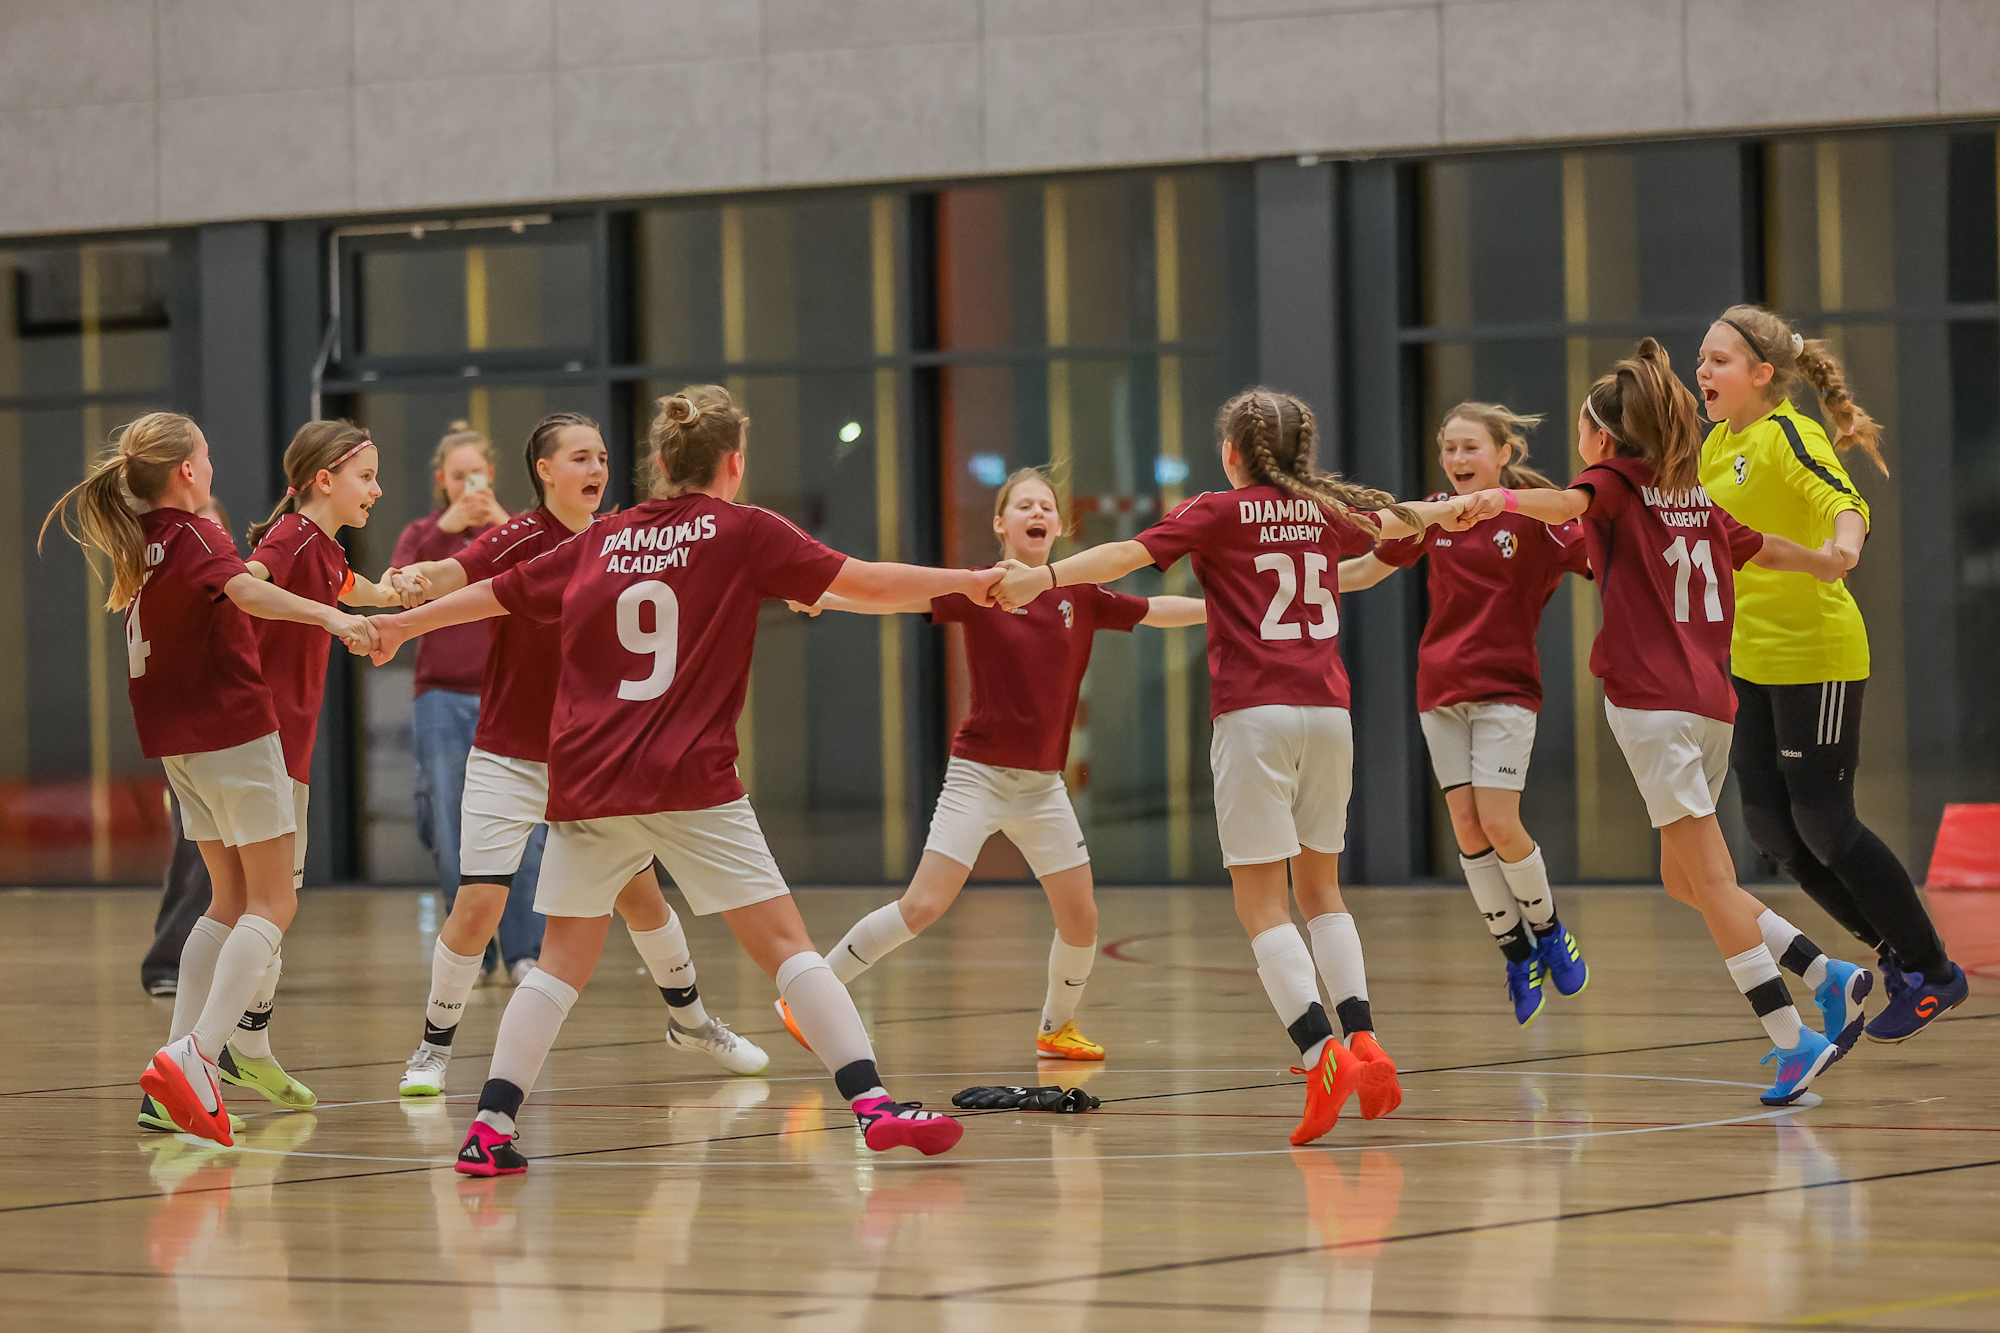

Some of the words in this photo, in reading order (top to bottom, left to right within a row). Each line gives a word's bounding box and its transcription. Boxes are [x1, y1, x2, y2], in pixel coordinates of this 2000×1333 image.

[1239, 499, 1329, 526] DIAMON
[1259, 524, 1324, 543] ACADEMY
[606, 547, 691, 574] ACADEMY
[1662, 535, 1724, 622] 11
[1253, 551, 1340, 641] 25
[616, 579, 679, 701] 9
[432, 999, 462, 1010] JAKO
